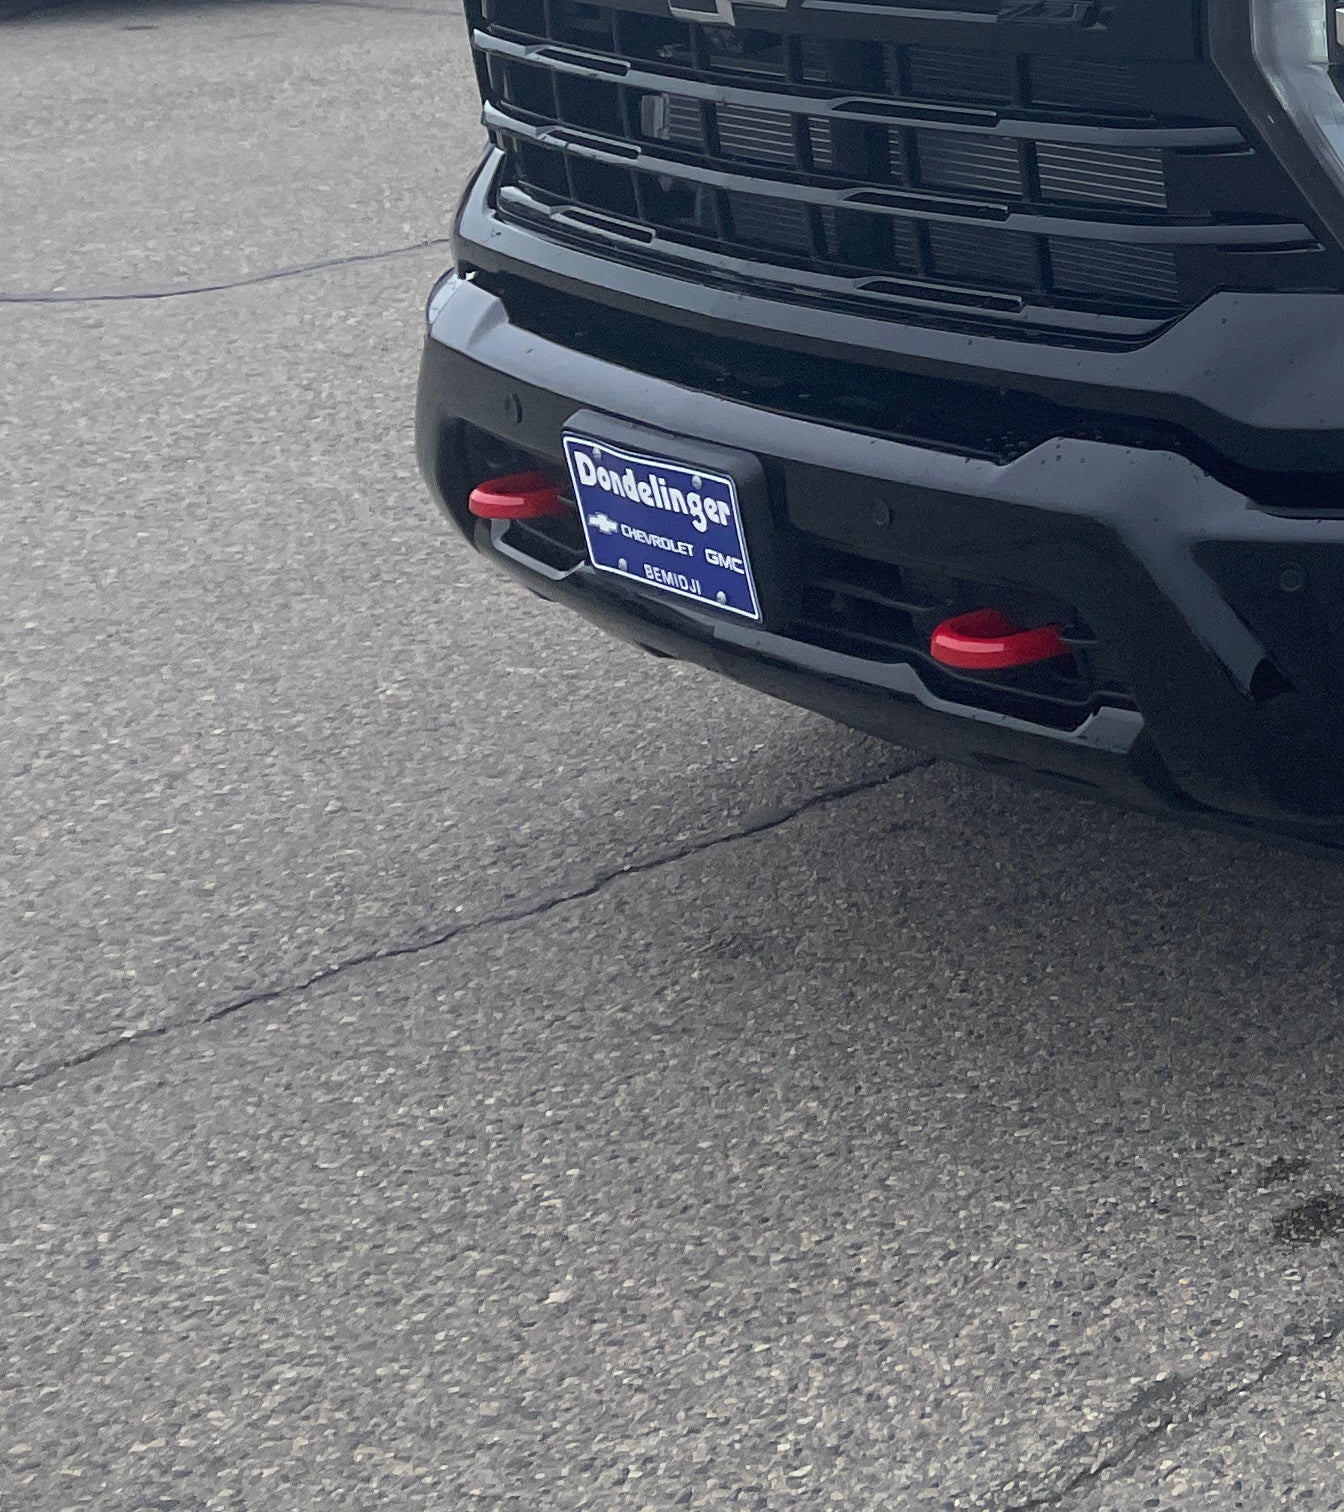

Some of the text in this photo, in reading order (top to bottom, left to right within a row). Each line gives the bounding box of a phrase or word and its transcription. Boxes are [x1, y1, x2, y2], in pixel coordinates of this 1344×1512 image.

[573, 450, 731, 533] Dondelinger
[620, 523, 746, 575] CHEVROLET GMC
[643, 563, 702, 595] BEMIDJI
